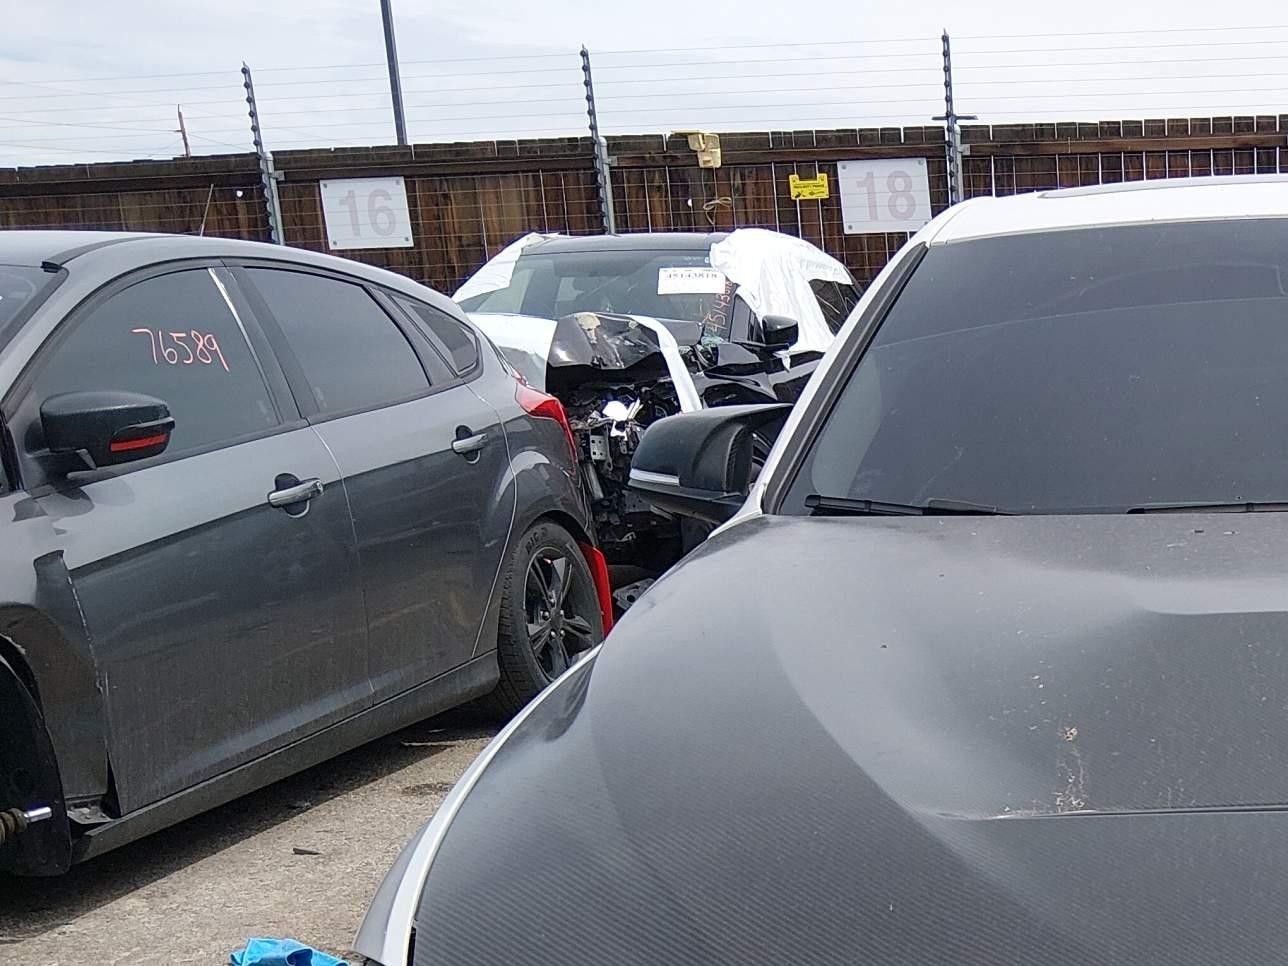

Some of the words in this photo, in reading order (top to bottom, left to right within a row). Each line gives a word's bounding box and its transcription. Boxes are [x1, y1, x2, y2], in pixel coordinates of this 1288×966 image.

[338, 188, 396, 237] 16
[856, 170, 916, 222] 18
[131, 328, 230, 372] 76589
